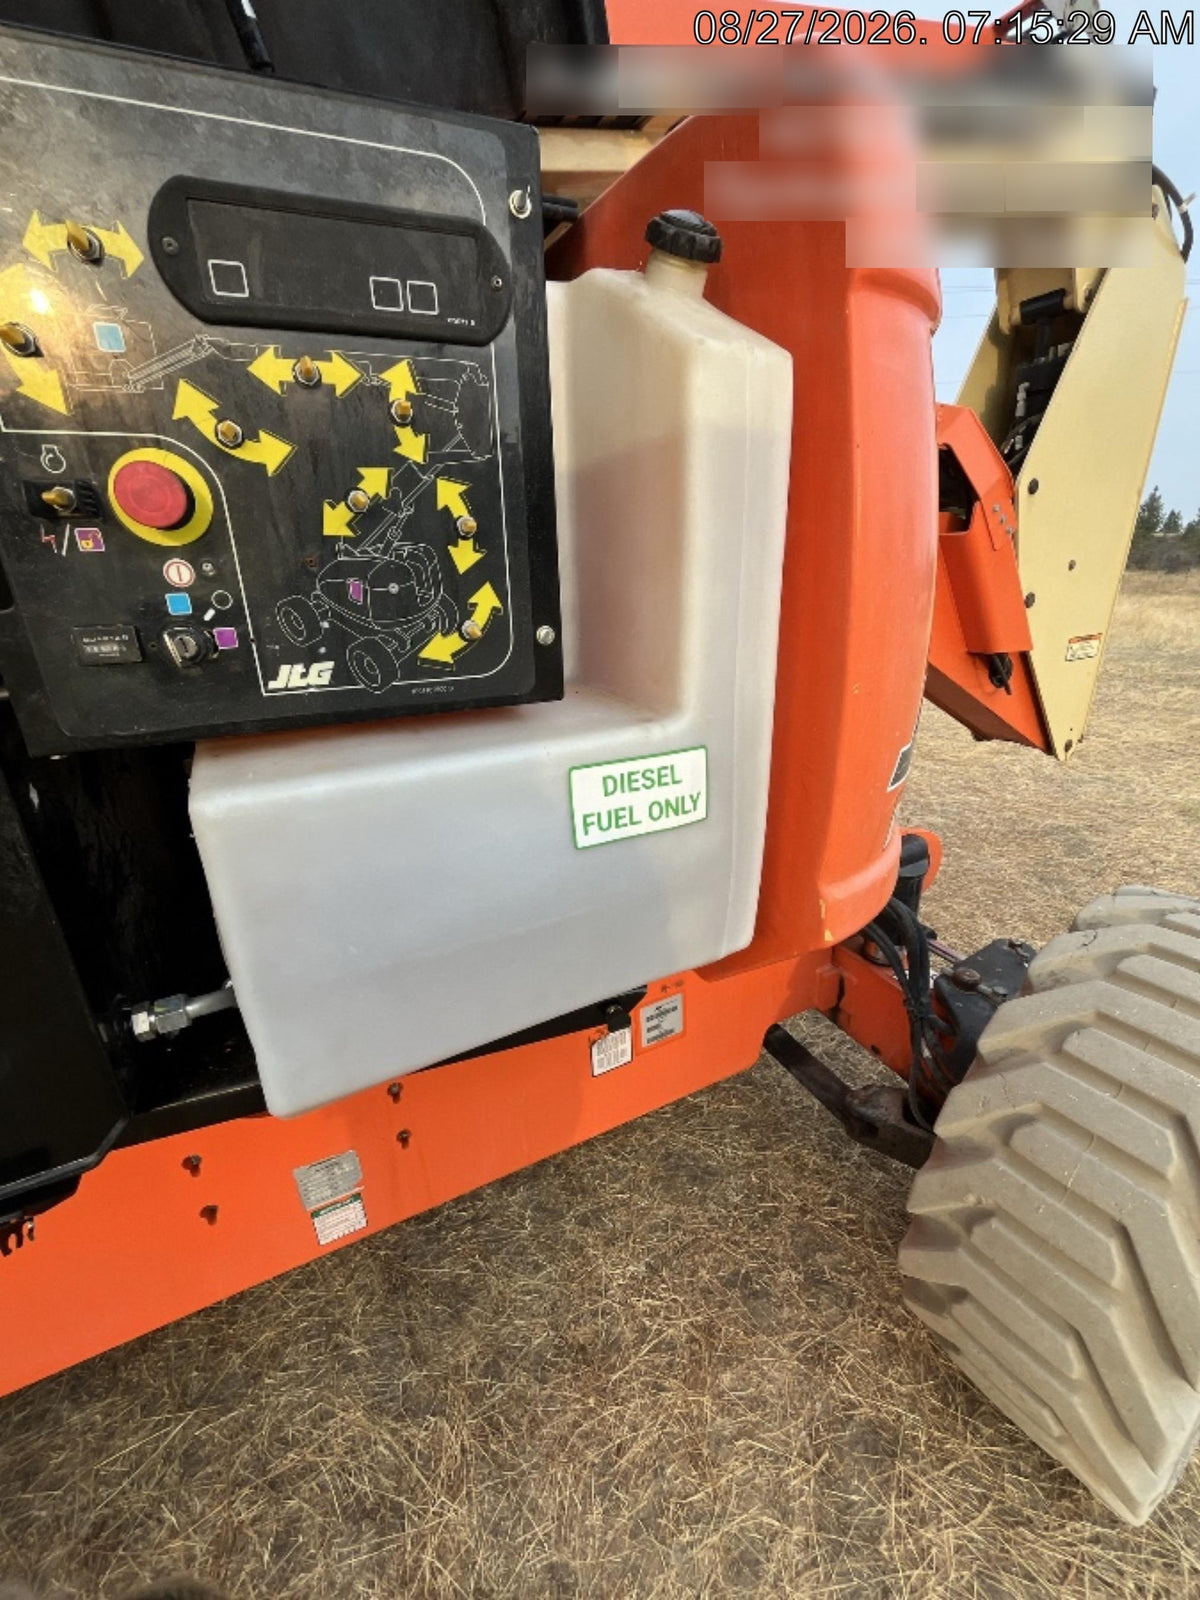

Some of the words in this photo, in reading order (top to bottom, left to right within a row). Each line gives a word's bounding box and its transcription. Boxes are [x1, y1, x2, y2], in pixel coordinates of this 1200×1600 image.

[602, 764, 683, 797] DIESEL
[582, 805, 643, 836] FUEL
[648, 791, 701, 822] ONLY
